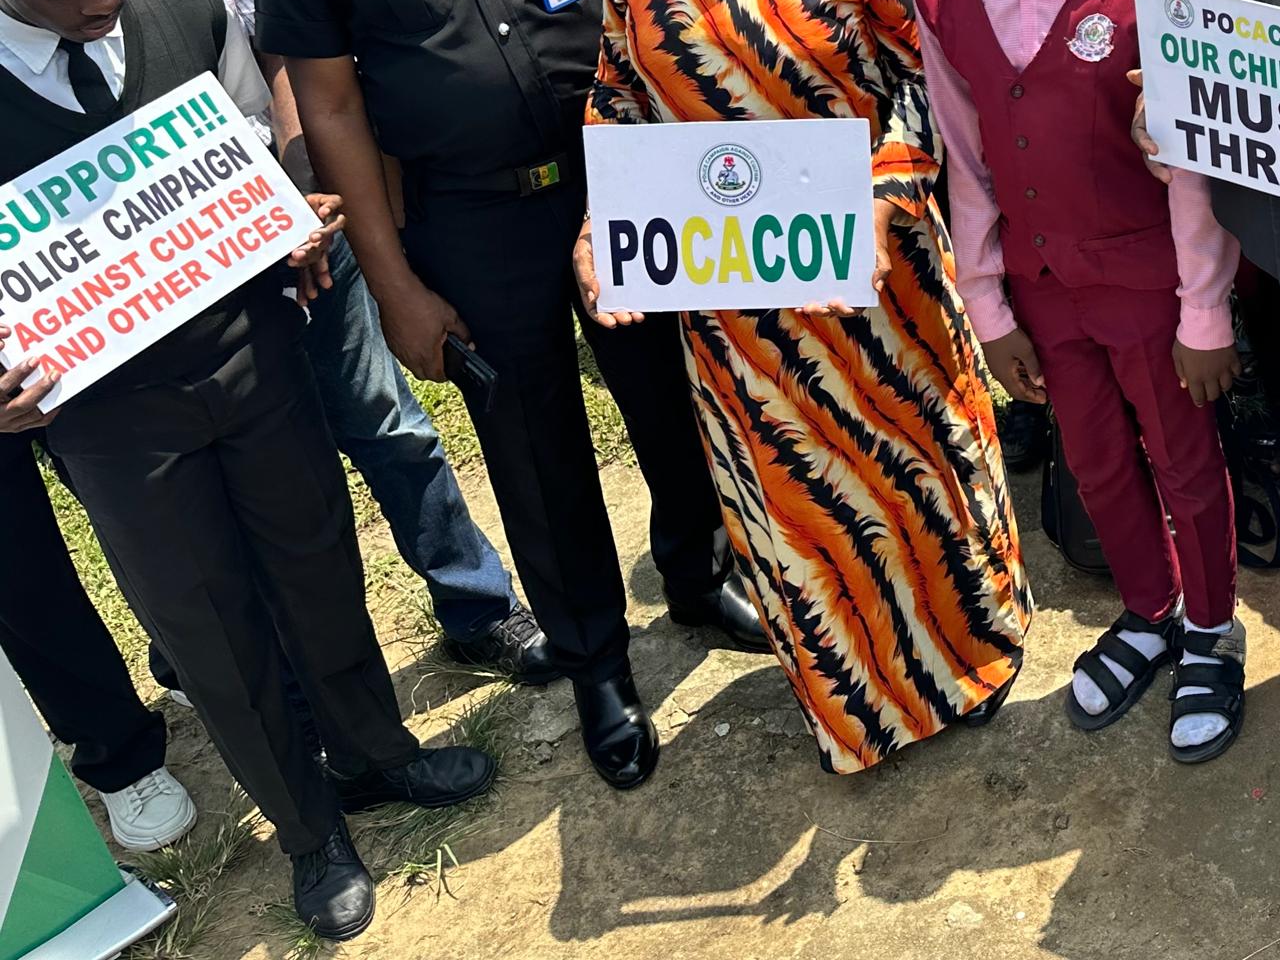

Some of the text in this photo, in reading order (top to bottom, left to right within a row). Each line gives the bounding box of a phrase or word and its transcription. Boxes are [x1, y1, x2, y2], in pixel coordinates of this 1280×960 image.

[1161, 32, 1221, 74] OUR
[0, 91, 228, 251] SUPPORT!!!
[0, 136, 253, 316] OLICE CAMPAIGN
[608, 213, 857, 286] POCACOV
[13, 174, 276, 352] AGAINST CULTISM
[37, 206, 295, 376] AND OTHER VICES
